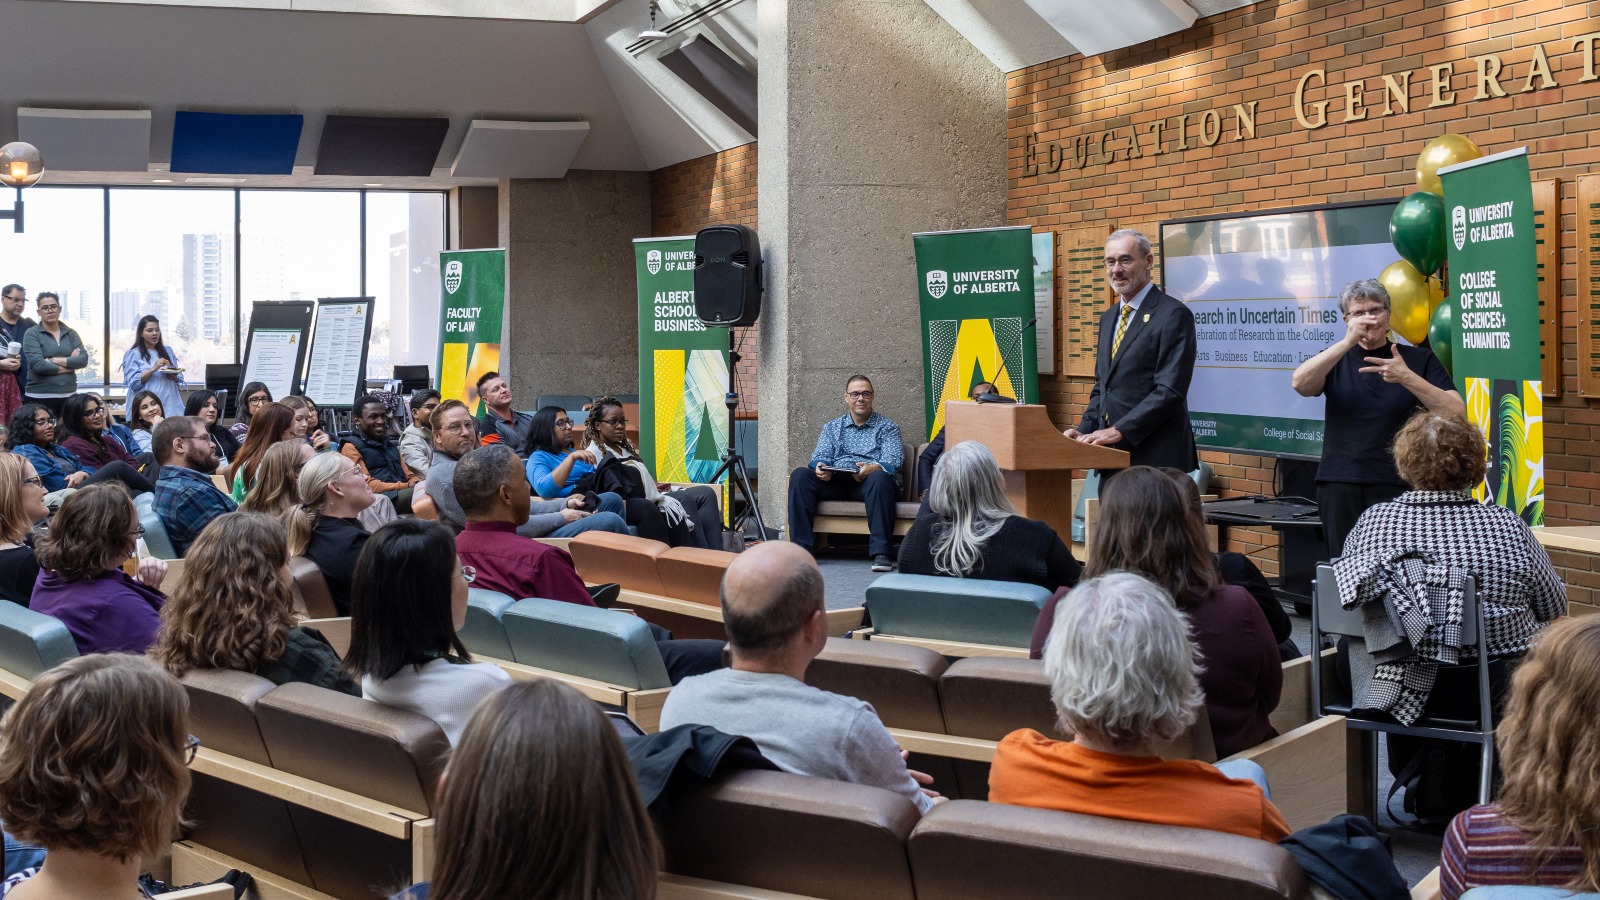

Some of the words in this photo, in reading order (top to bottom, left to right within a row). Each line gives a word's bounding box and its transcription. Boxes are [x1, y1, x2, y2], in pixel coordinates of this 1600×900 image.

[1022, 101, 1259, 178] EDUCATION
[1469, 201, 1514, 224] UNIVERSITY
[1470, 227, 1481, 243] OF
[1481, 222, 1514, 242] ALBERTA
[665, 262, 675, 272] OF
[952, 269, 1019, 282] UNIVERSITY
[1460, 270, 1496, 290] COLLEGE
[953, 283, 968, 294] OF
[970, 282, 1020, 294] ALBERTA
[1460, 292, 1473, 310] OF
[1475, 291, 1502, 309] SOCIAL
[447, 307, 481, 319] FACULTY
[654, 305, 697, 318] SCHOOL
[1226, 307, 1237, 324] in
[1239, 306, 1296, 324] Uncertain
[1298, 306, 1338, 324] Times
[445, 321, 457, 332] OF
[458, 321, 475, 332] LAW
[654, 319, 707, 332] BUSINESS
[1229, 328, 1238, 341] of
[1238, 329, 1275, 341] Research
[1276, 329, 1285, 341] in
[1287, 328, 1301, 341] the
[1302, 328, 1335, 344] College
[1462, 331, 1511, 350] HUMANITIES
[1214, 351, 1248, 362] Business
[1253, 351, 1293, 363] Education
[1190, 419, 1217, 429] NIVERSITY
[1195, 428, 1218, 437] ALBERTA
[1263, 427, 1286, 440] College
[1287, 428, 1294, 439] of
[1295, 429, 1315, 441] Social
